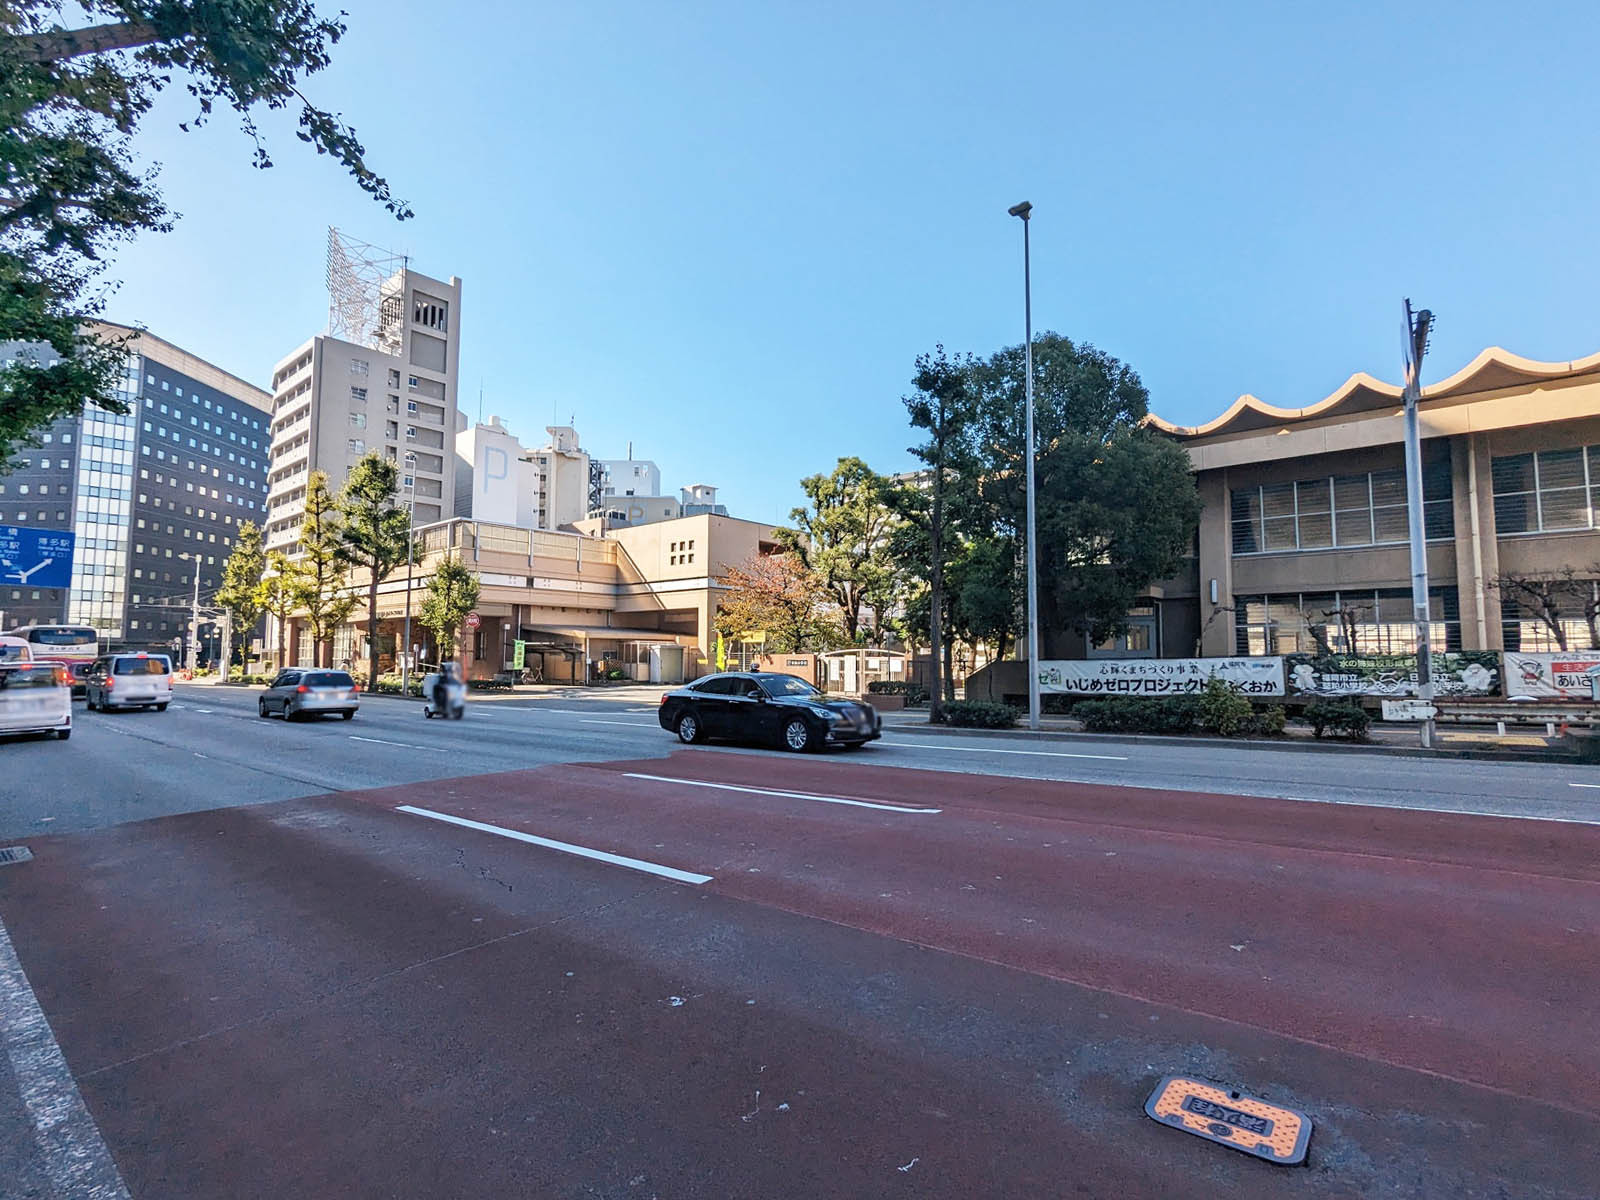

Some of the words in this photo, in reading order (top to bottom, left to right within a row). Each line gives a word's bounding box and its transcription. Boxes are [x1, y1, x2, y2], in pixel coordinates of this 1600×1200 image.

[484, 446, 508, 494] P
[1066, 677, 1208, 693] いじめゼロプロジェクト
